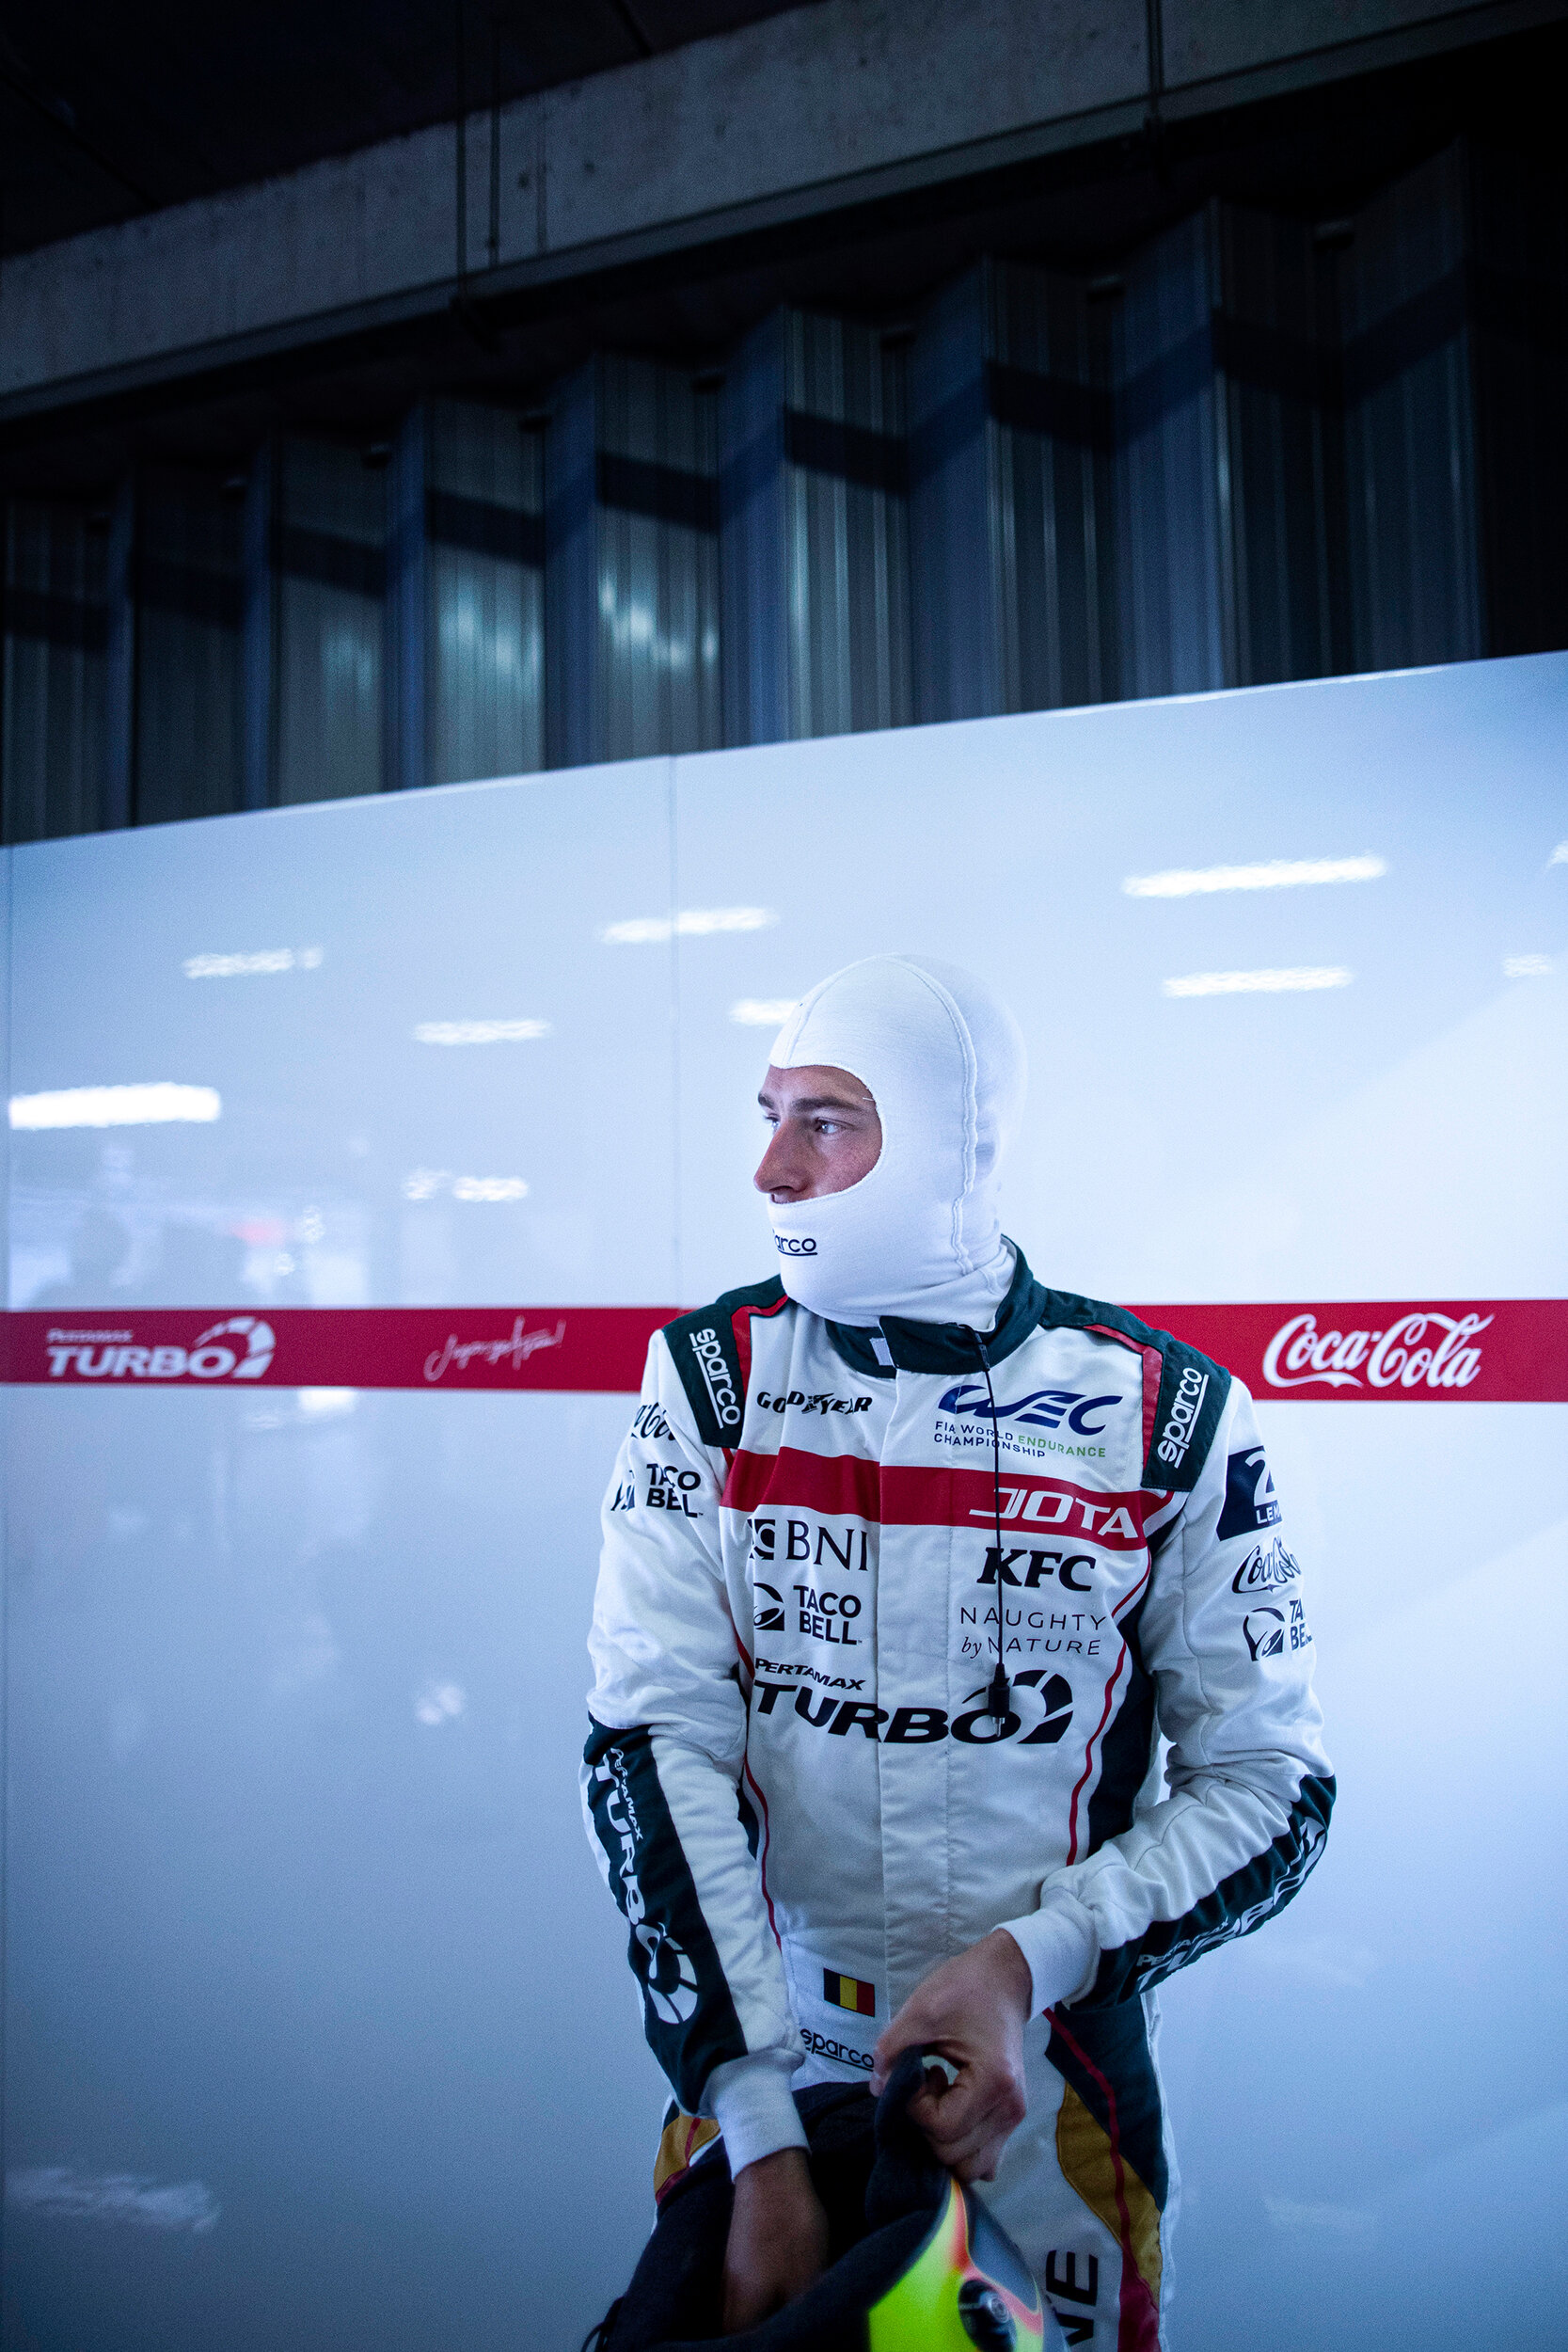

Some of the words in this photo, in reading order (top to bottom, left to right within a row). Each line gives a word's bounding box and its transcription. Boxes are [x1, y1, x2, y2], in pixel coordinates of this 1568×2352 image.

[773, 1228, 818, 1257] arco
[47, 1345, 237, 1378] TURBO
[1261, 1313, 1494, 1388] Coca-Cola
[689, 1328, 743, 1429] sparco
[1157, 1367, 1209, 1468] sparco
[934, 1432, 1046, 1458] CHAMPIONSHIP
[935, 1421, 957, 1435] FIA
[960, 1424, 1014, 1441] WORLD
[1018, 1435, 1106, 1458] ENDURANCE
[646, 1463, 702, 1491] TACO
[968, 1486, 1139, 1539] JOTA
[784, 1519, 869, 1572] BNI
[976, 1546, 1097, 1592] KFC
[793, 1584, 862, 1619] TACO
[960, 1607, 1106, 1631] NAUGHTY
[800, 1613, 860, 1645] BELL
[961, 1636, 982, 1659] by
[988, 1636, 1101, 1656] NATURE
[754, 1658, 866, 1691] PERTAMAX
[753, 1679, 1022, 1744] TURBO
[800, 2027, 875, 2071] sparco
[1045, 2249, 1099, 2346] VE
